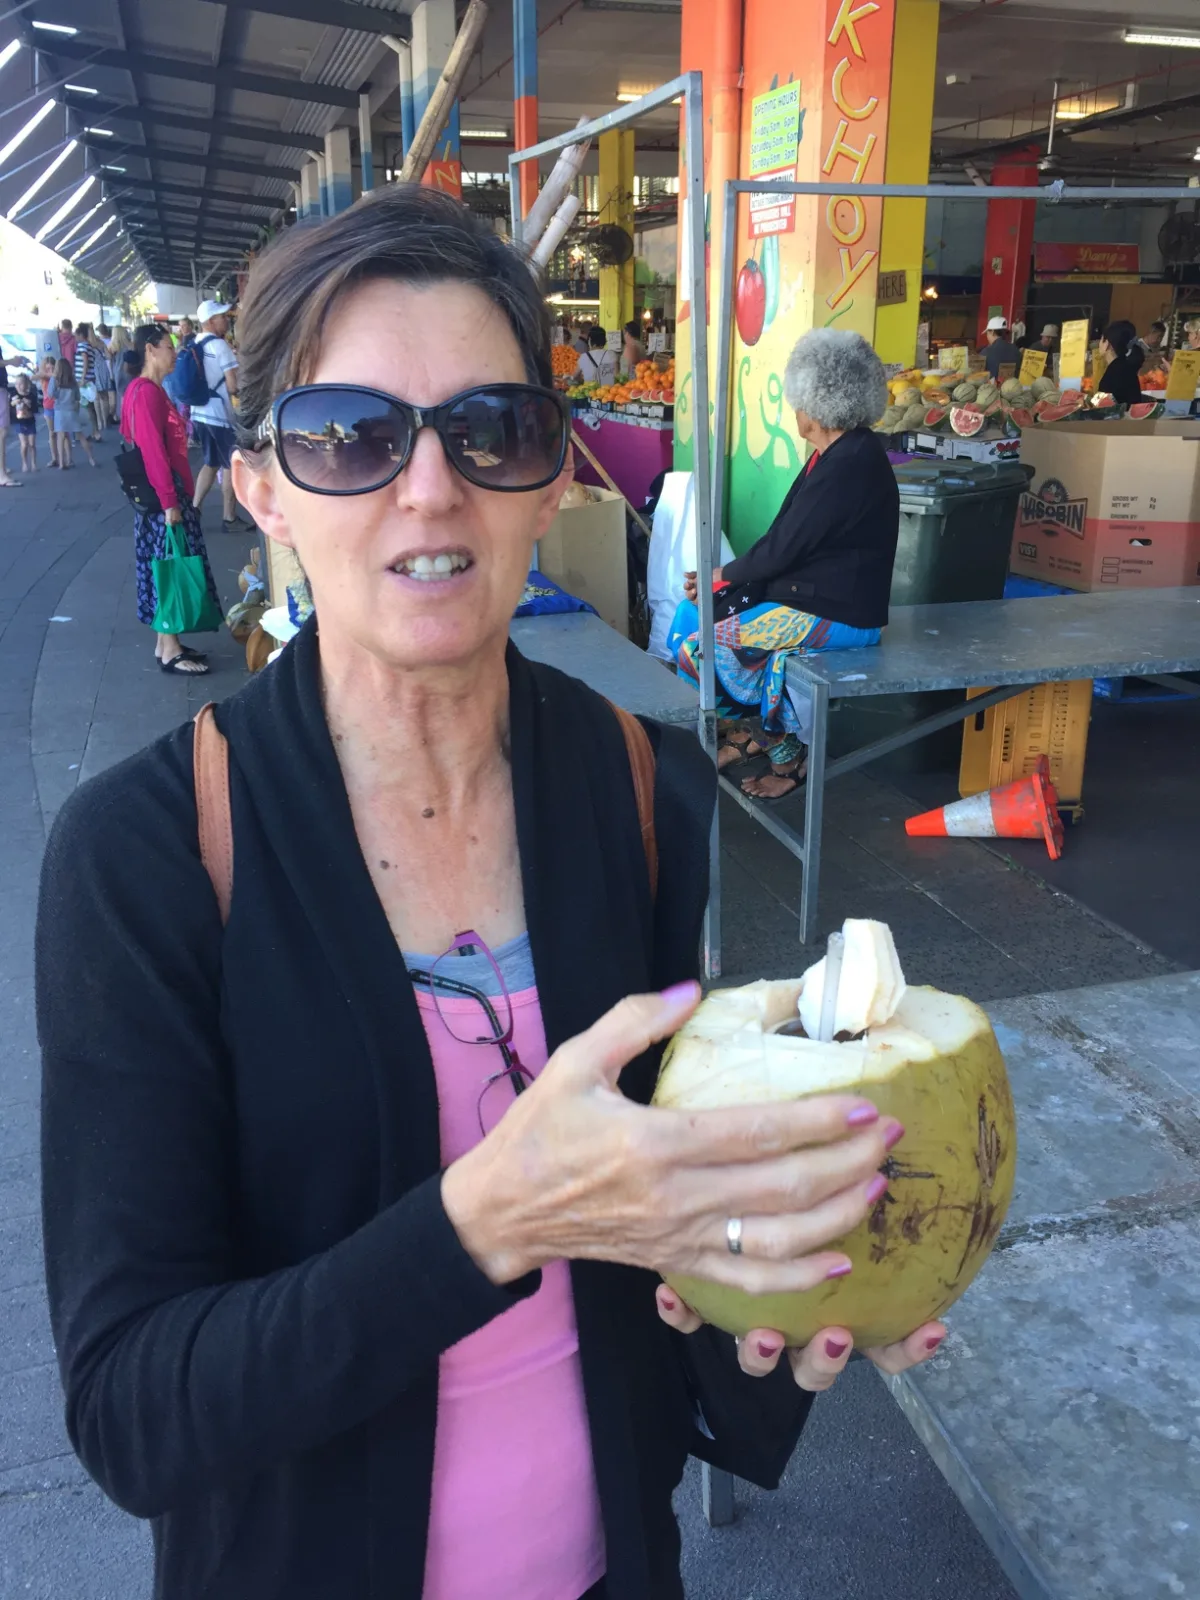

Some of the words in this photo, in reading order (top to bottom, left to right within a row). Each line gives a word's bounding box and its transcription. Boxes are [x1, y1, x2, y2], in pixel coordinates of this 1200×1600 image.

[754, 98, 776, 117] OPENING
[778, 90, 798, 107] HOURS
[752, 157, 769, 170] Sunday
[878, 273, 905, 299] HERE
